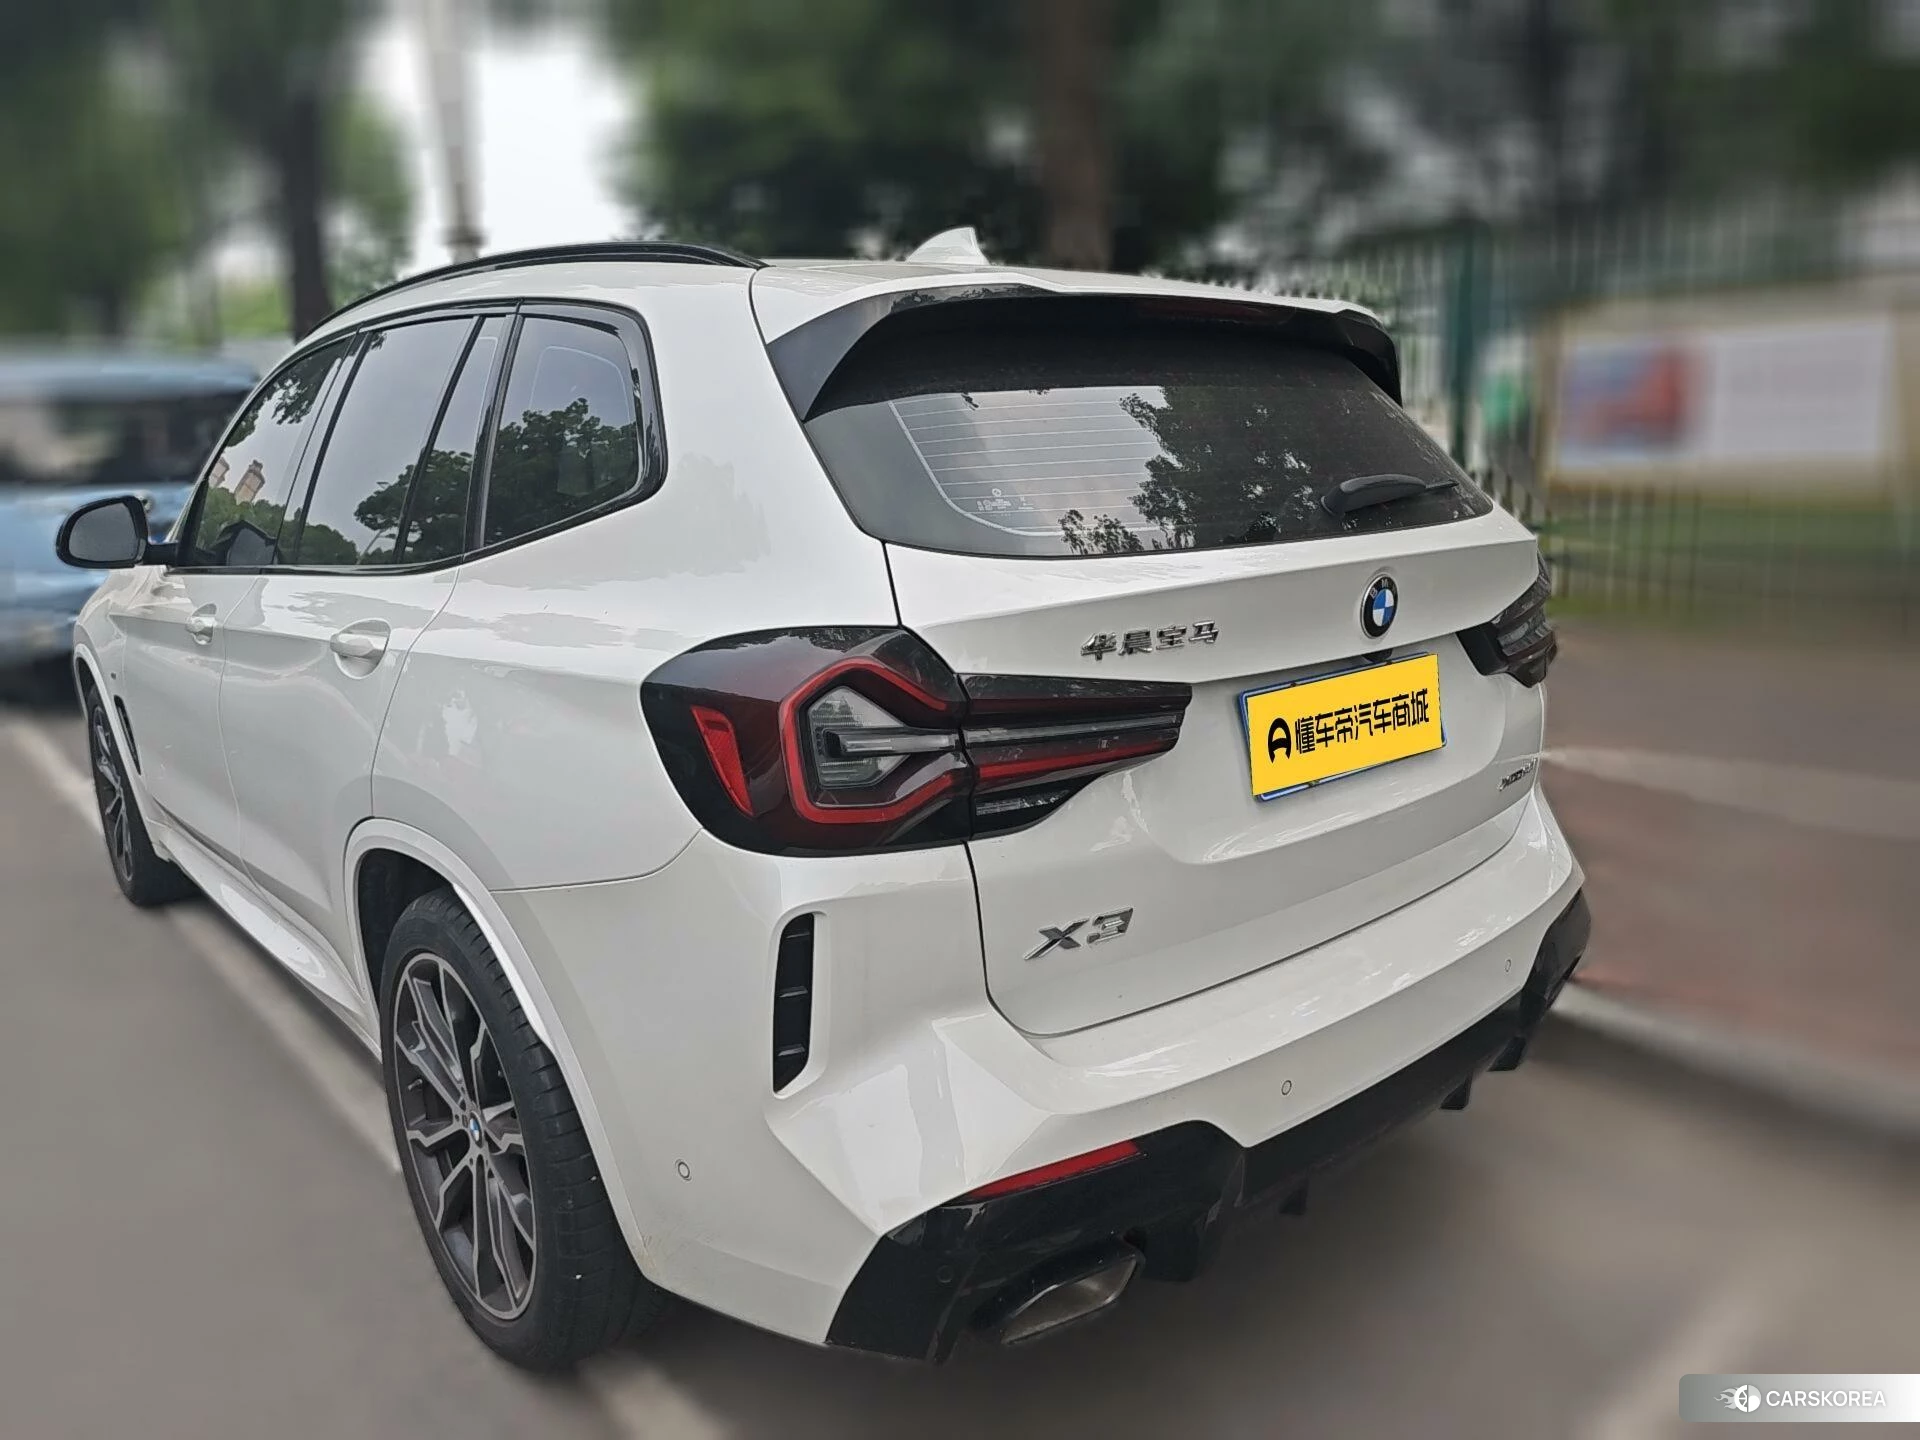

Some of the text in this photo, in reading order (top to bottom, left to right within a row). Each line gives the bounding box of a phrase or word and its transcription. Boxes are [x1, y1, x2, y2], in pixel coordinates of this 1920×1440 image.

[1081, 620, 1219, 661] 华晨宝马
[1023, 905, 1134, 961] X3
